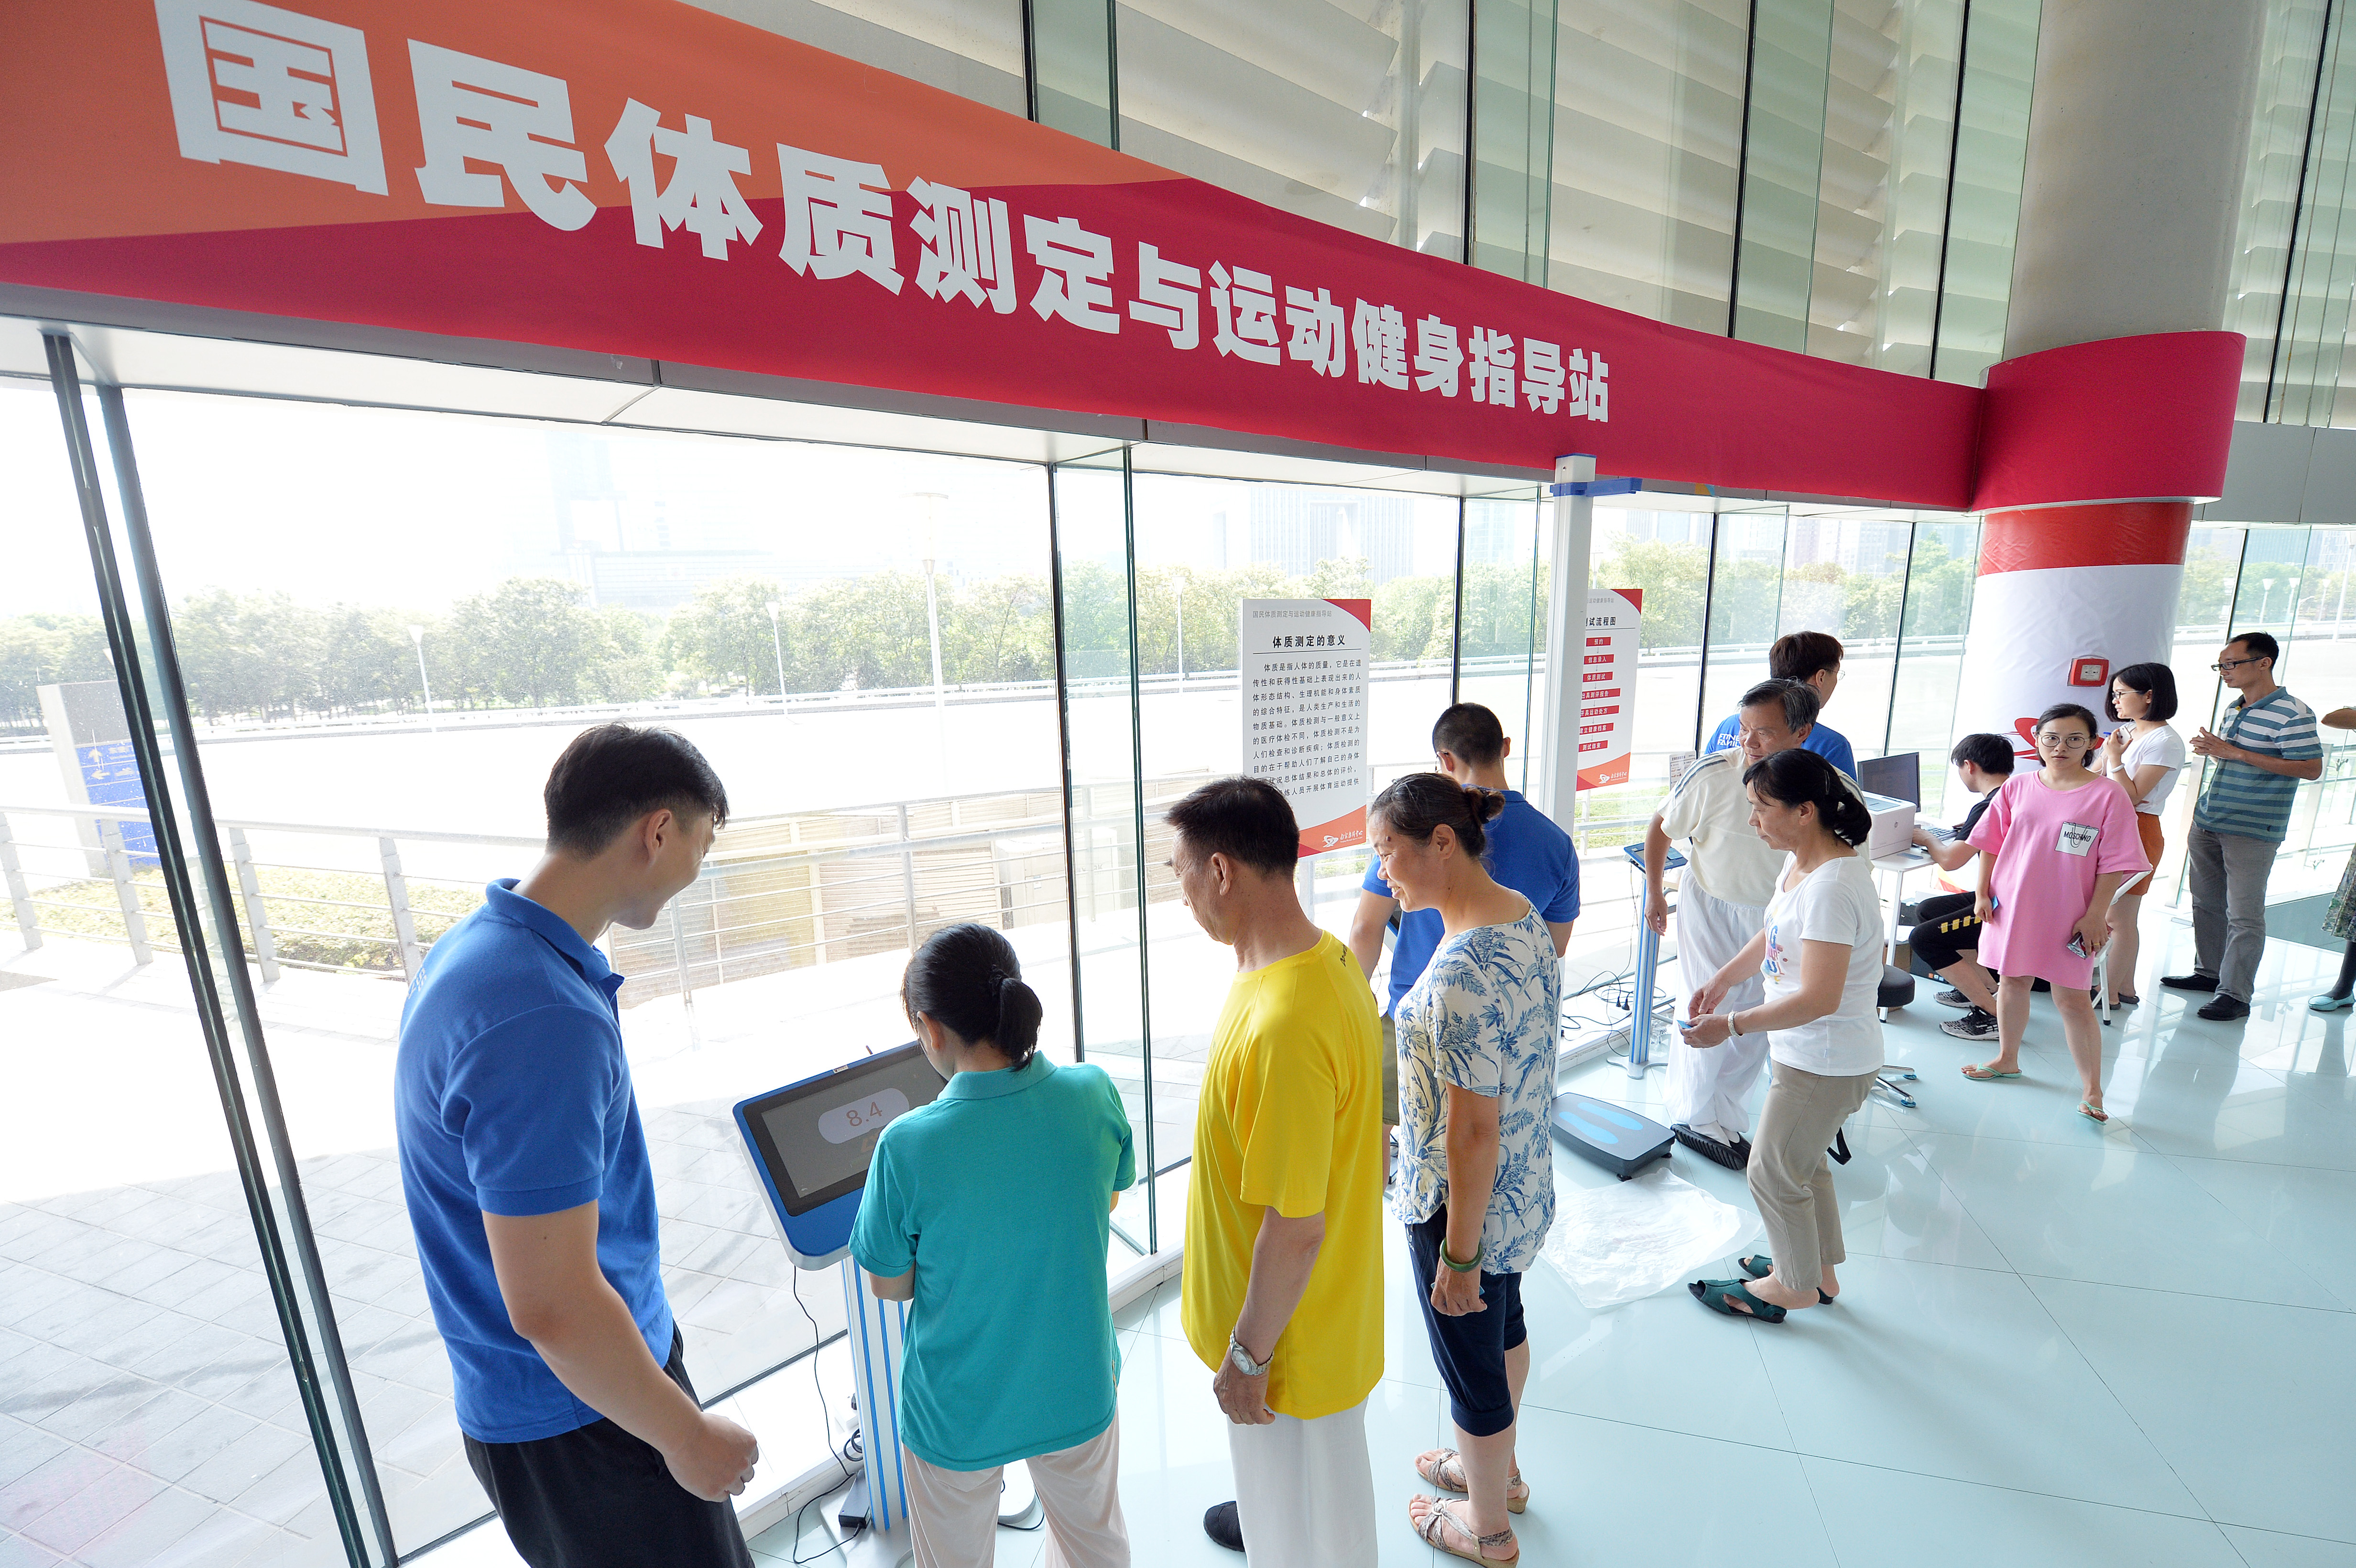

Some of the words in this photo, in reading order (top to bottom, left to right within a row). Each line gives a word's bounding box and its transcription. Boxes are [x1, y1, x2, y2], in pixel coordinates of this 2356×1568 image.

[154, 0, 1608, 424] 国民体质测定与运动健身指导站
[1253, 610, 1332, 618] 国民体质测定与运动健康指导站
[1273, 634, 1345, 648] 体质测定的意义
[1264, 659, 1362, 672] 体质是指人体的质量，它是在遗
[1253, 672, 1361, 687] 传性和获得性基础上表现出来的人
[1253, 686, 1361, 702] 体形态结构、生理机能和身体素质
[1253, 699, 1360, 716] 的综合特征，是人类生产和生活的
[1253, 712, 1360, 730] 物质基础。体质检测与一般意义上
[1253, 726, 1360, 745] 的医疗体检不同，体质检测不是为
[1253, 739, 1360, 759] 人们检查和诊断疾病；体质检测的
[1254, 752, 1360, 773] 目的在于帮助人们了解自己的身体
[2063, 831, 2092, 842] MOSCHINO
[846, 1101, 883, 1127] 8.4
